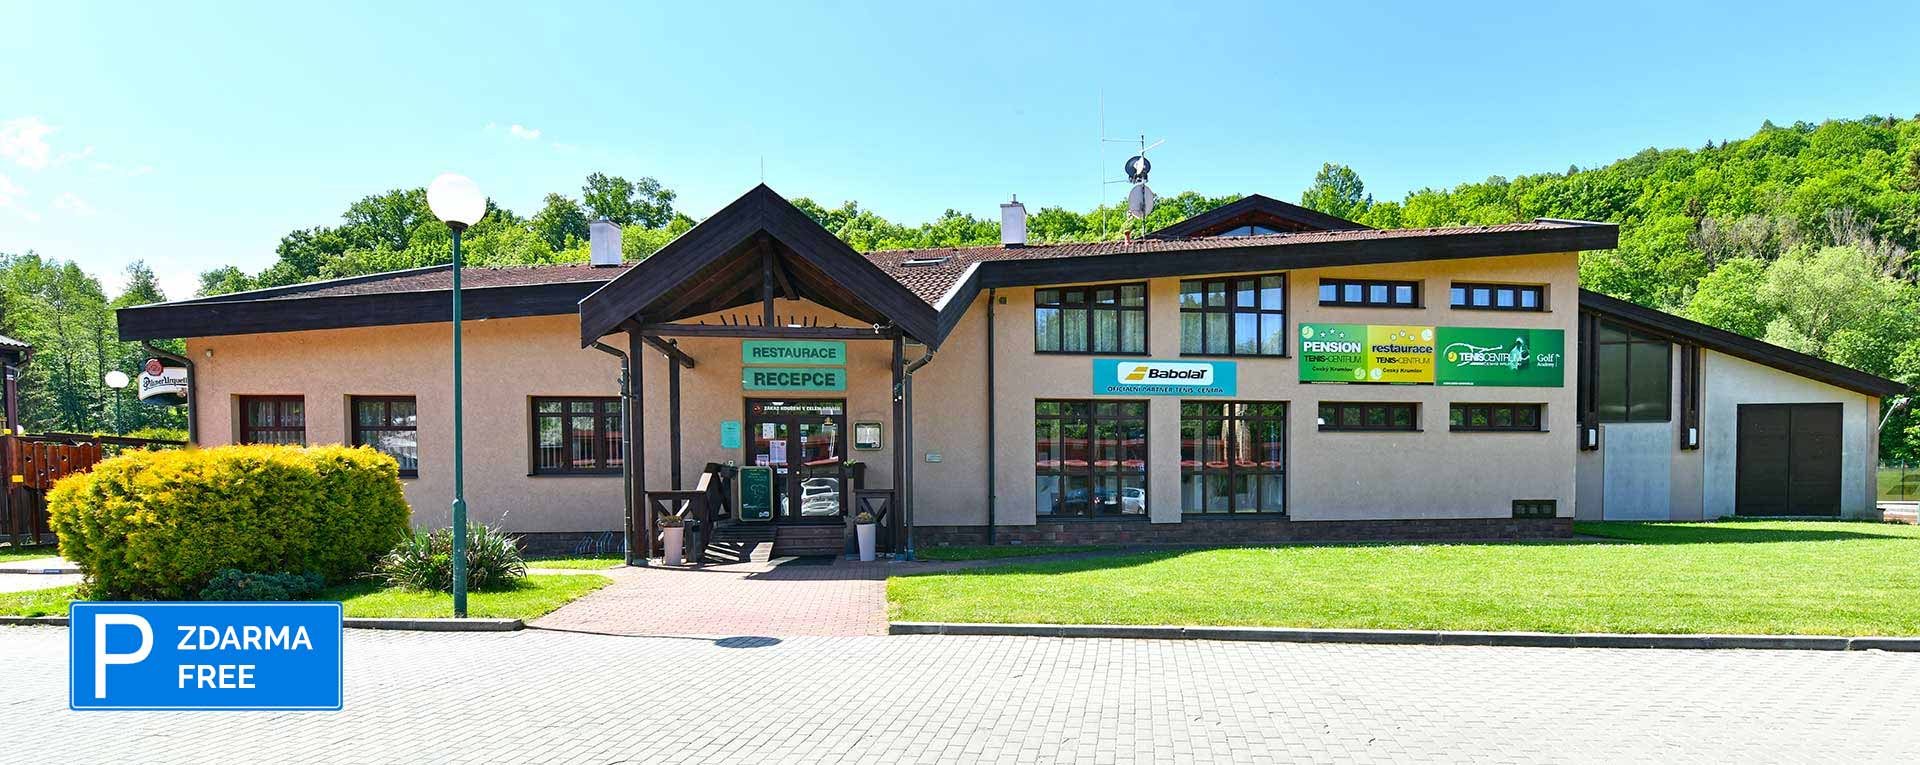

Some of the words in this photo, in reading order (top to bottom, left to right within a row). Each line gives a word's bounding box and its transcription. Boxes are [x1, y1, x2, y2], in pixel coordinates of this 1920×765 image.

[1303, 341, 1361, 353] PENSION
[1372, 344, 1433, 353] restaurace
[752, 347, 837, 359] RESTAURACE
[1537, 353, 1555, 363] Golf
[1304, 355, 1361, 363] TENIS-CENTRUM
[1376, 356, 1431, 364] TENIS-CENTRUM
[753, 372, 836, 386] RECEPCE
